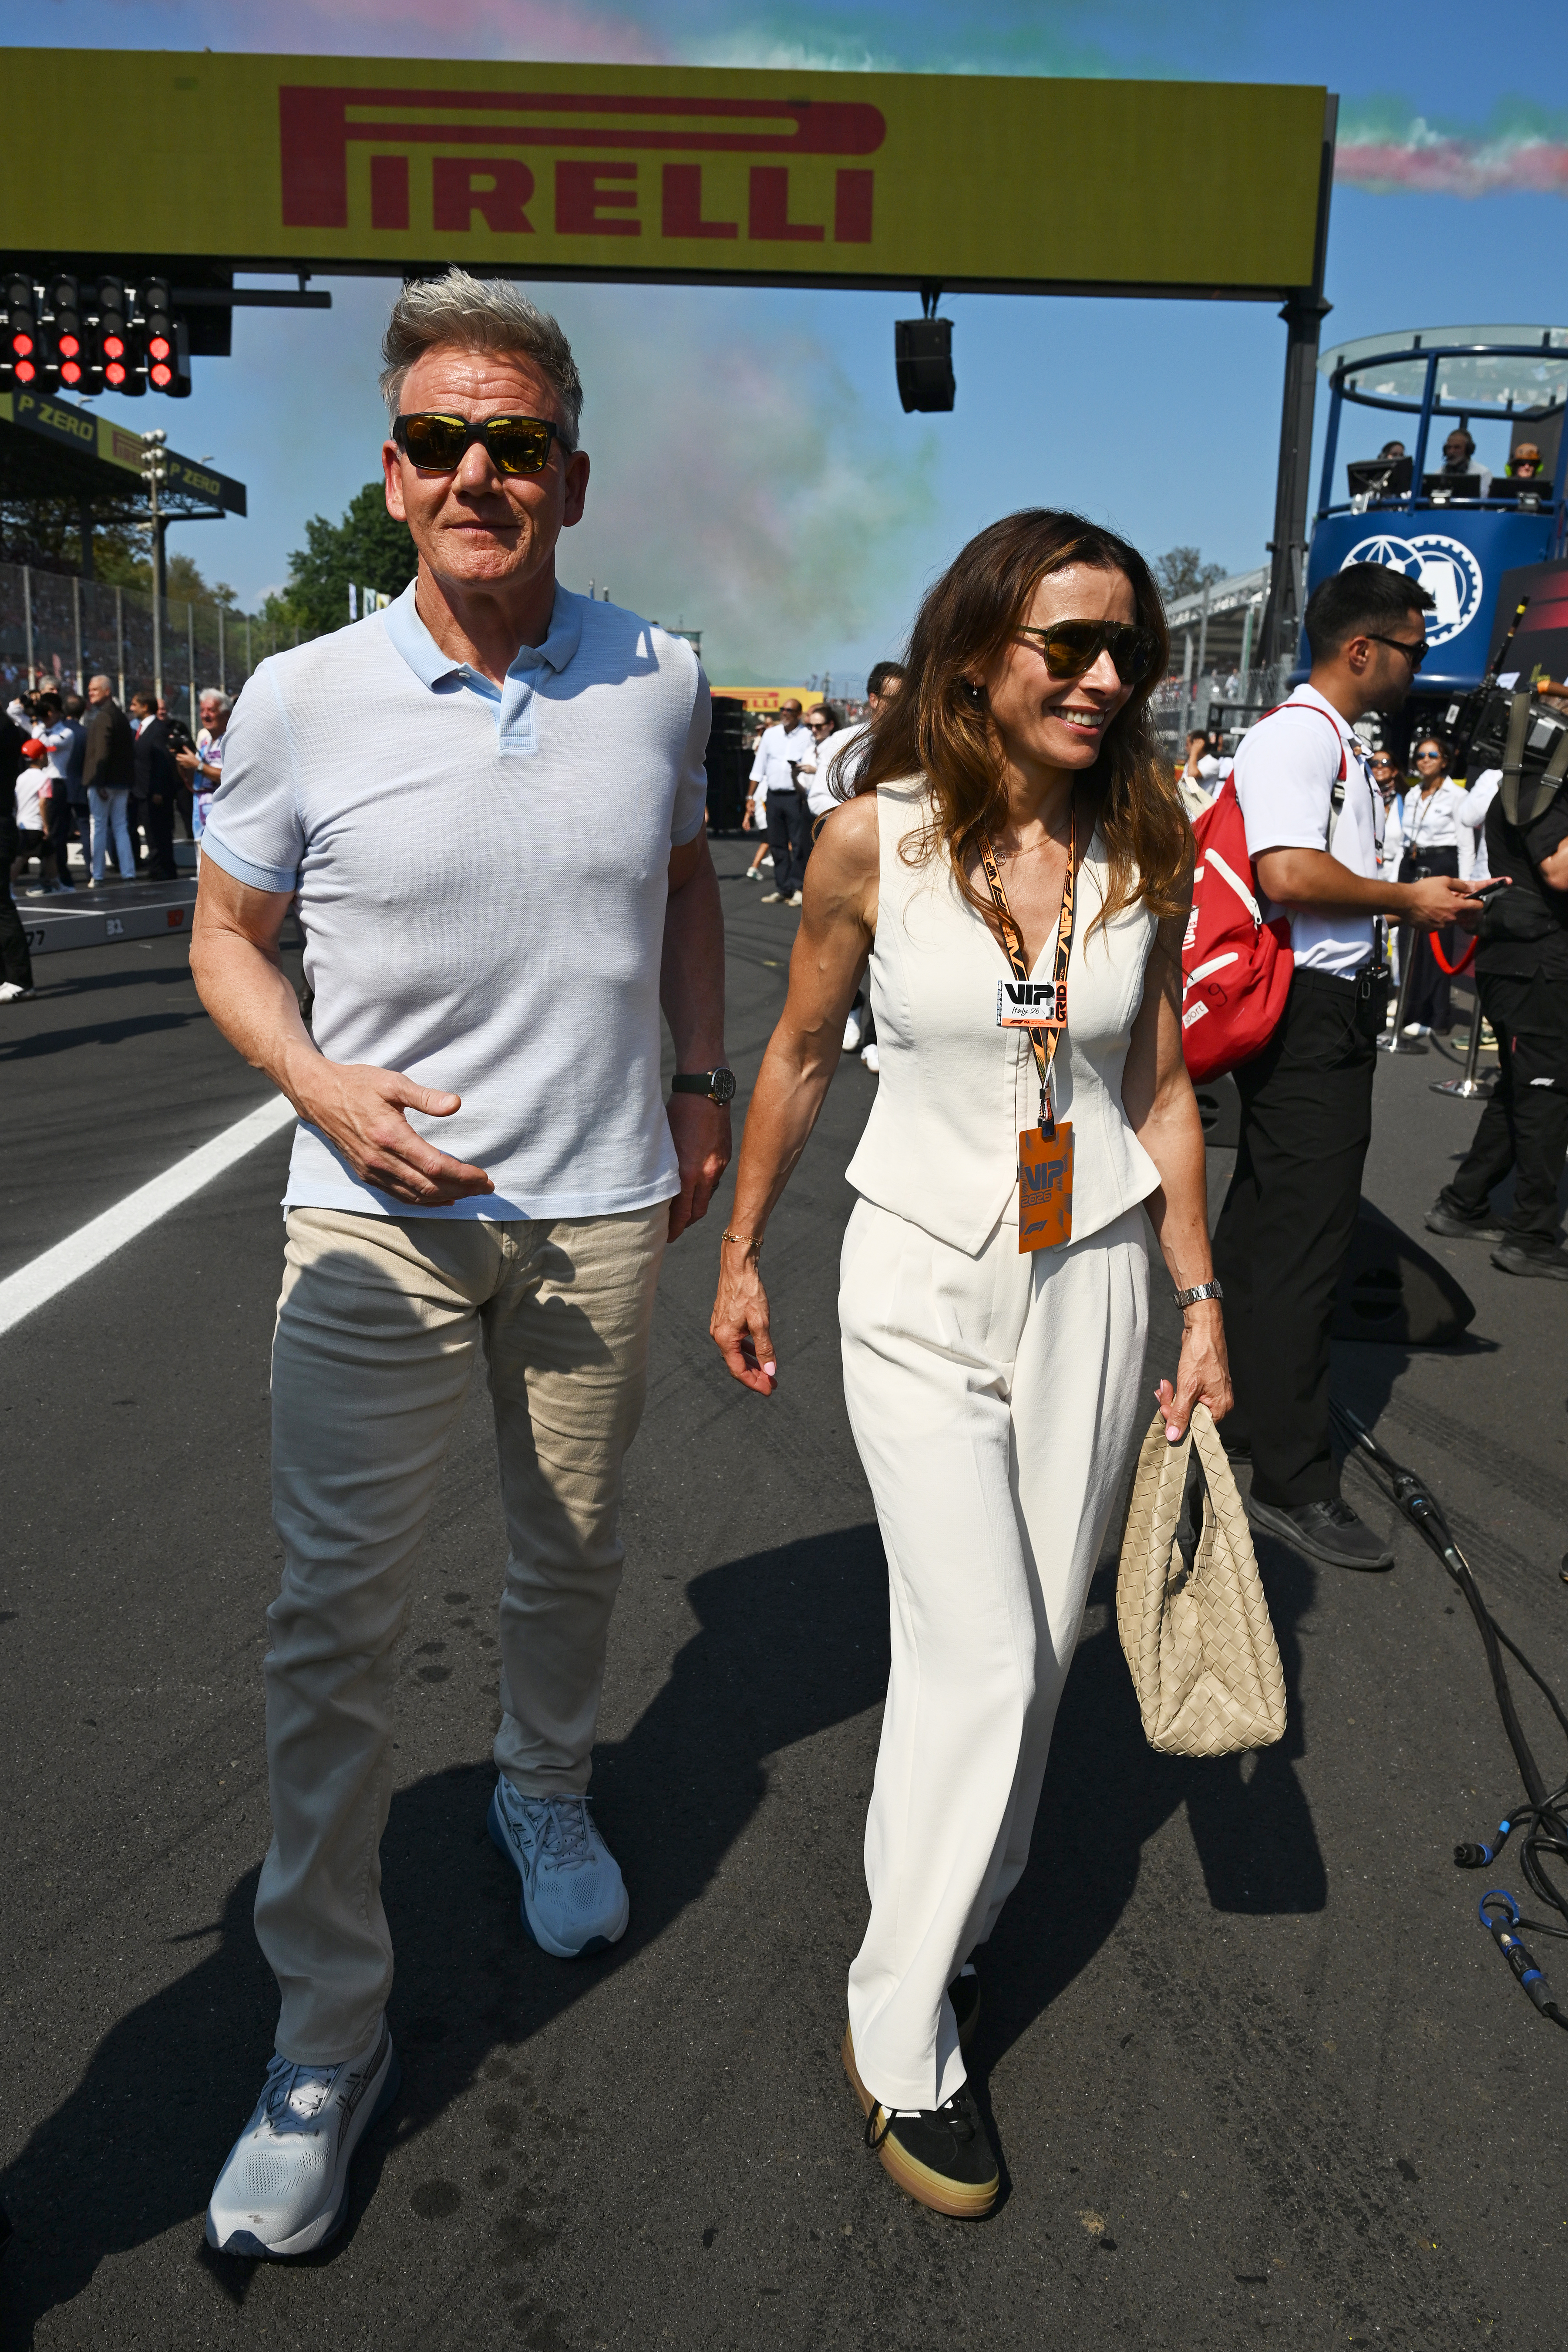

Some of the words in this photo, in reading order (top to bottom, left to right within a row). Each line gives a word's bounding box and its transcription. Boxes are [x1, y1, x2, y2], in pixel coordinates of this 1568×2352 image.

[279, 84, 886, 243] PIRELLI
[18, 394, 35, 412] P
[37, 401, 94, 441] ZERO
[169, 462, 181, 477] P
[182, 467, 221, 496] ZERO
[986, 861, 997, 883] VIP
[1059, 907, 1072, 940] VIP
[1004, 984, 1054, 1005] VIP
[1056, 985, 1067, 1022] GRID
[1012, 1007, 1028, 1016] Italy
[1184, 1004, 1205, 1024] sport
[1024, 1159, 1064, 1191] VIP
[1021, 1189, 1052, 1208] 2026
